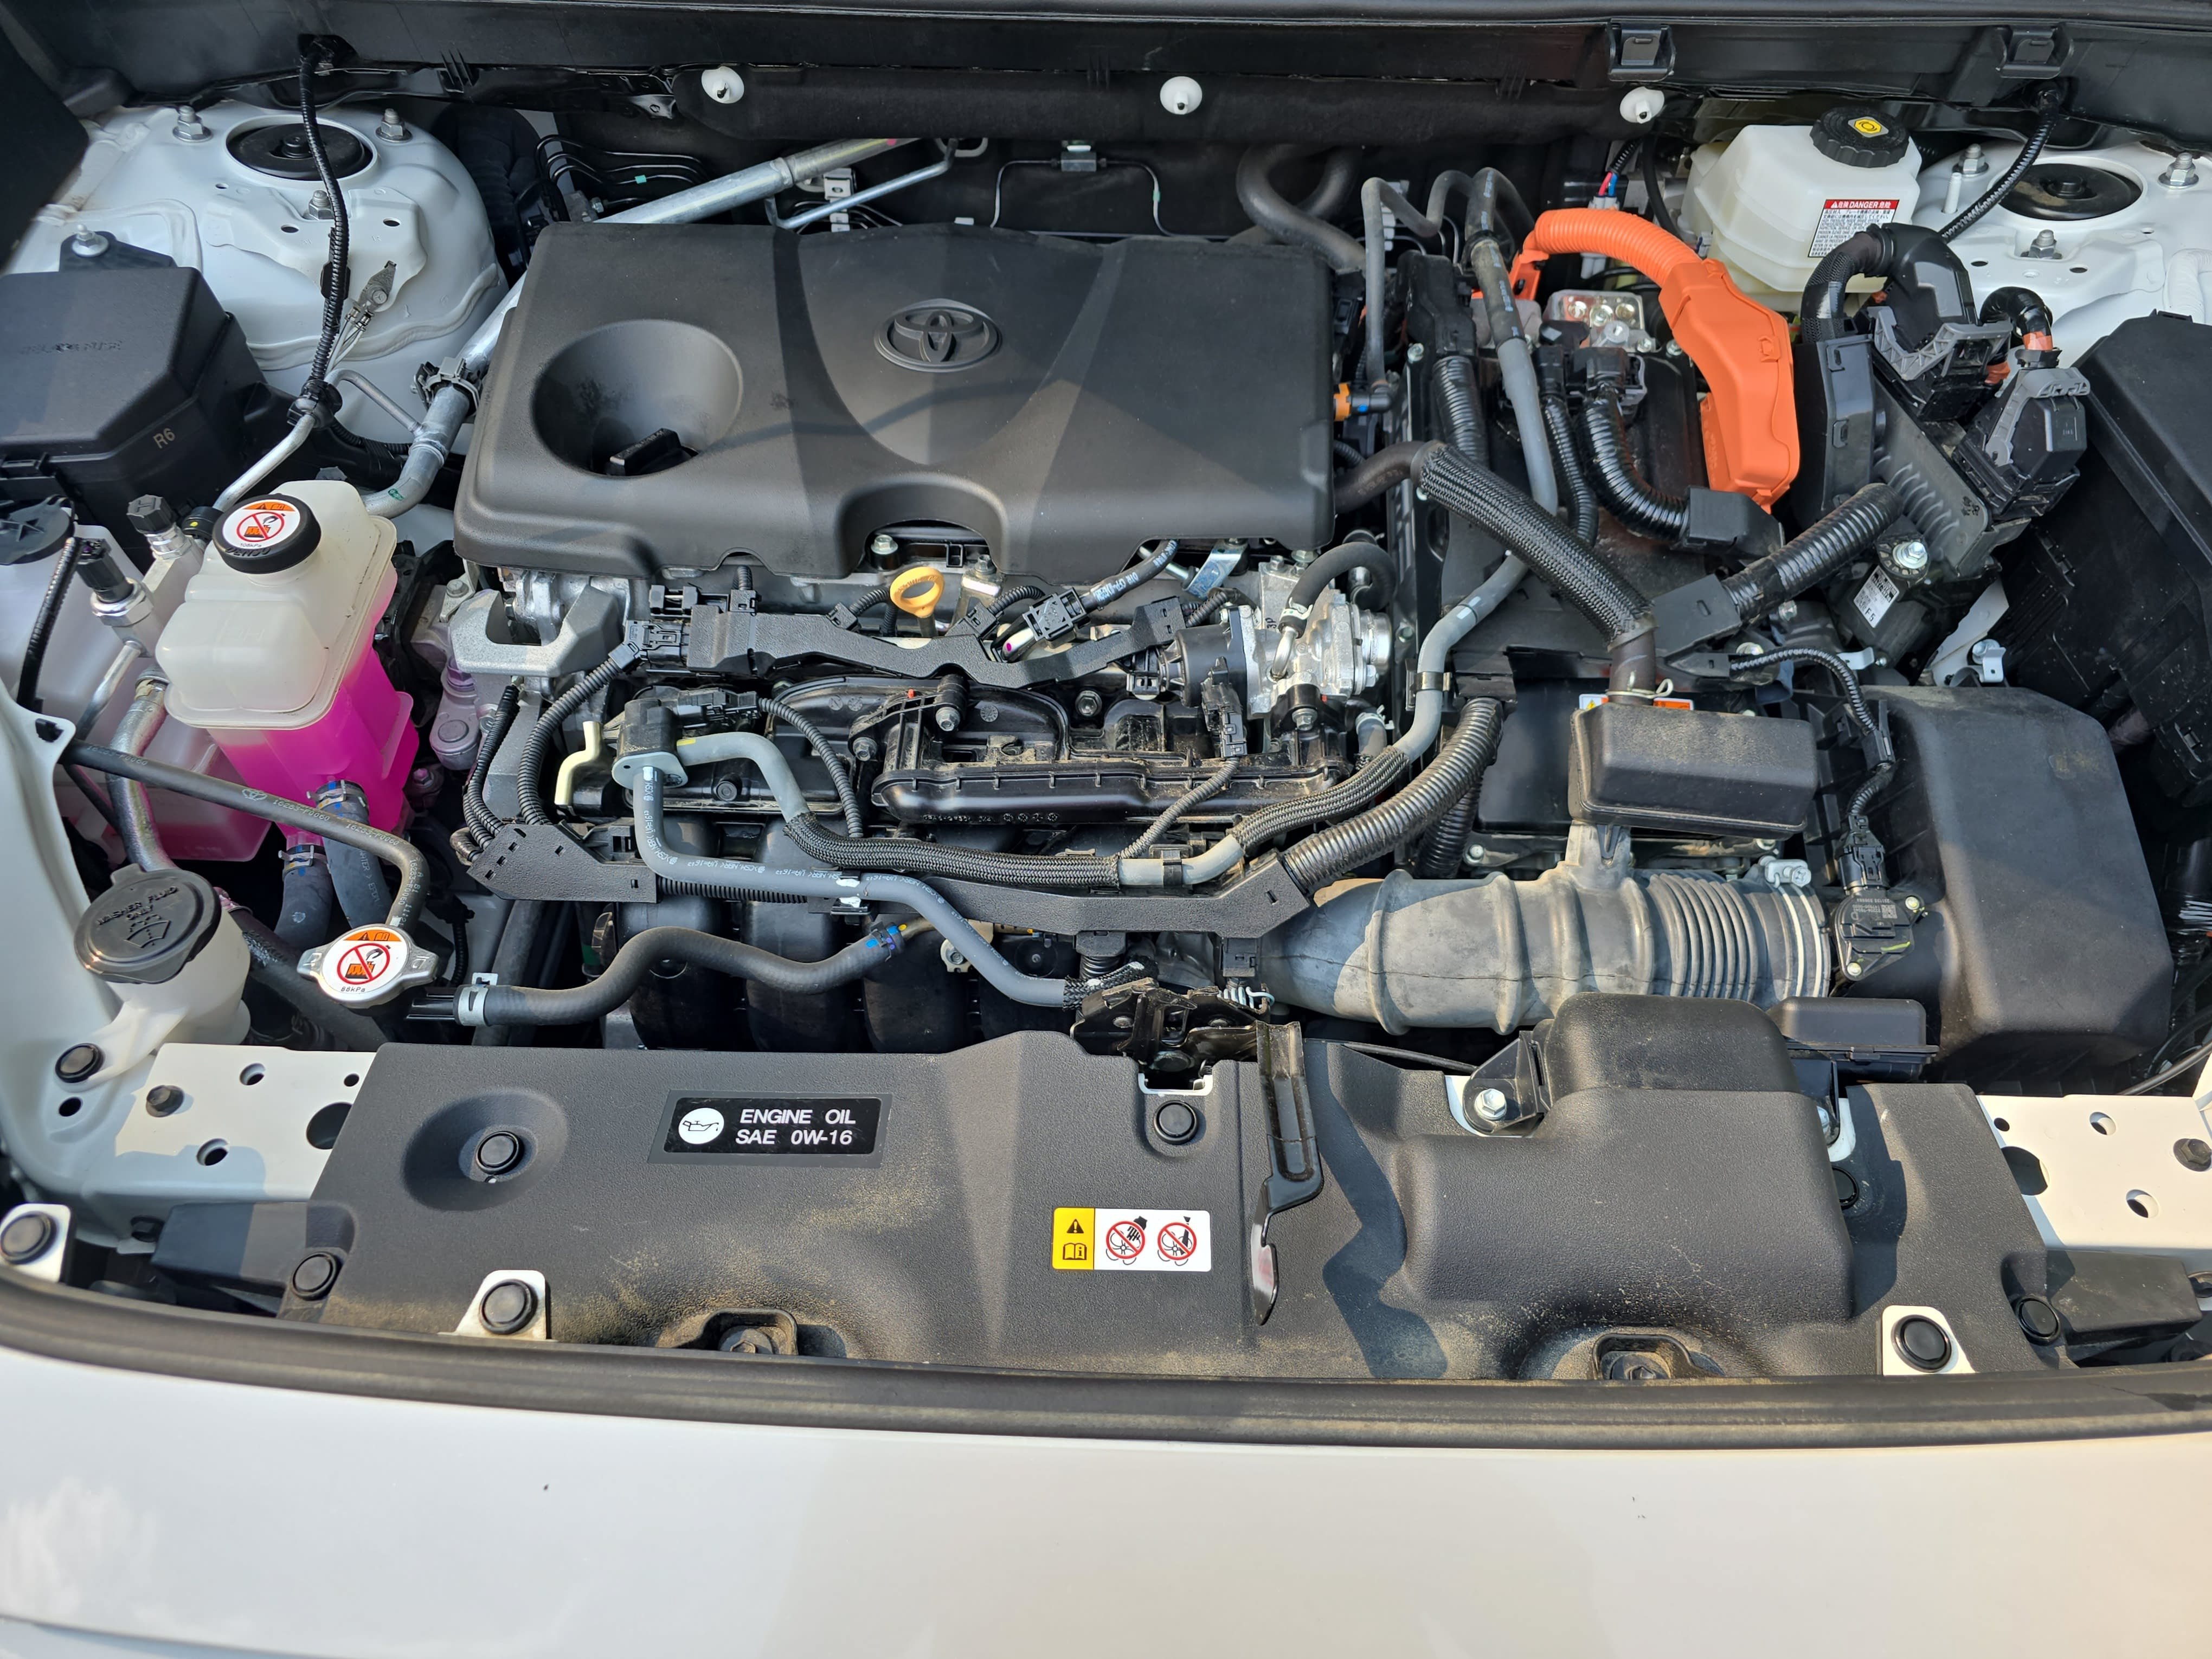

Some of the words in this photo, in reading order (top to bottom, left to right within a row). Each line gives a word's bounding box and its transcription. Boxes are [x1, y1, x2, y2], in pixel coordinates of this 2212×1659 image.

[153, 428, 176, 449] R6
[95, 901, 143, 925] WASHER
[740, 1108, 813, 1124] ENGINE
[825, 1109, 857, 1125] OIL
[735, 1129, 777, 1145] SAE
[790, 1129, 853, 1146] 0W-16
